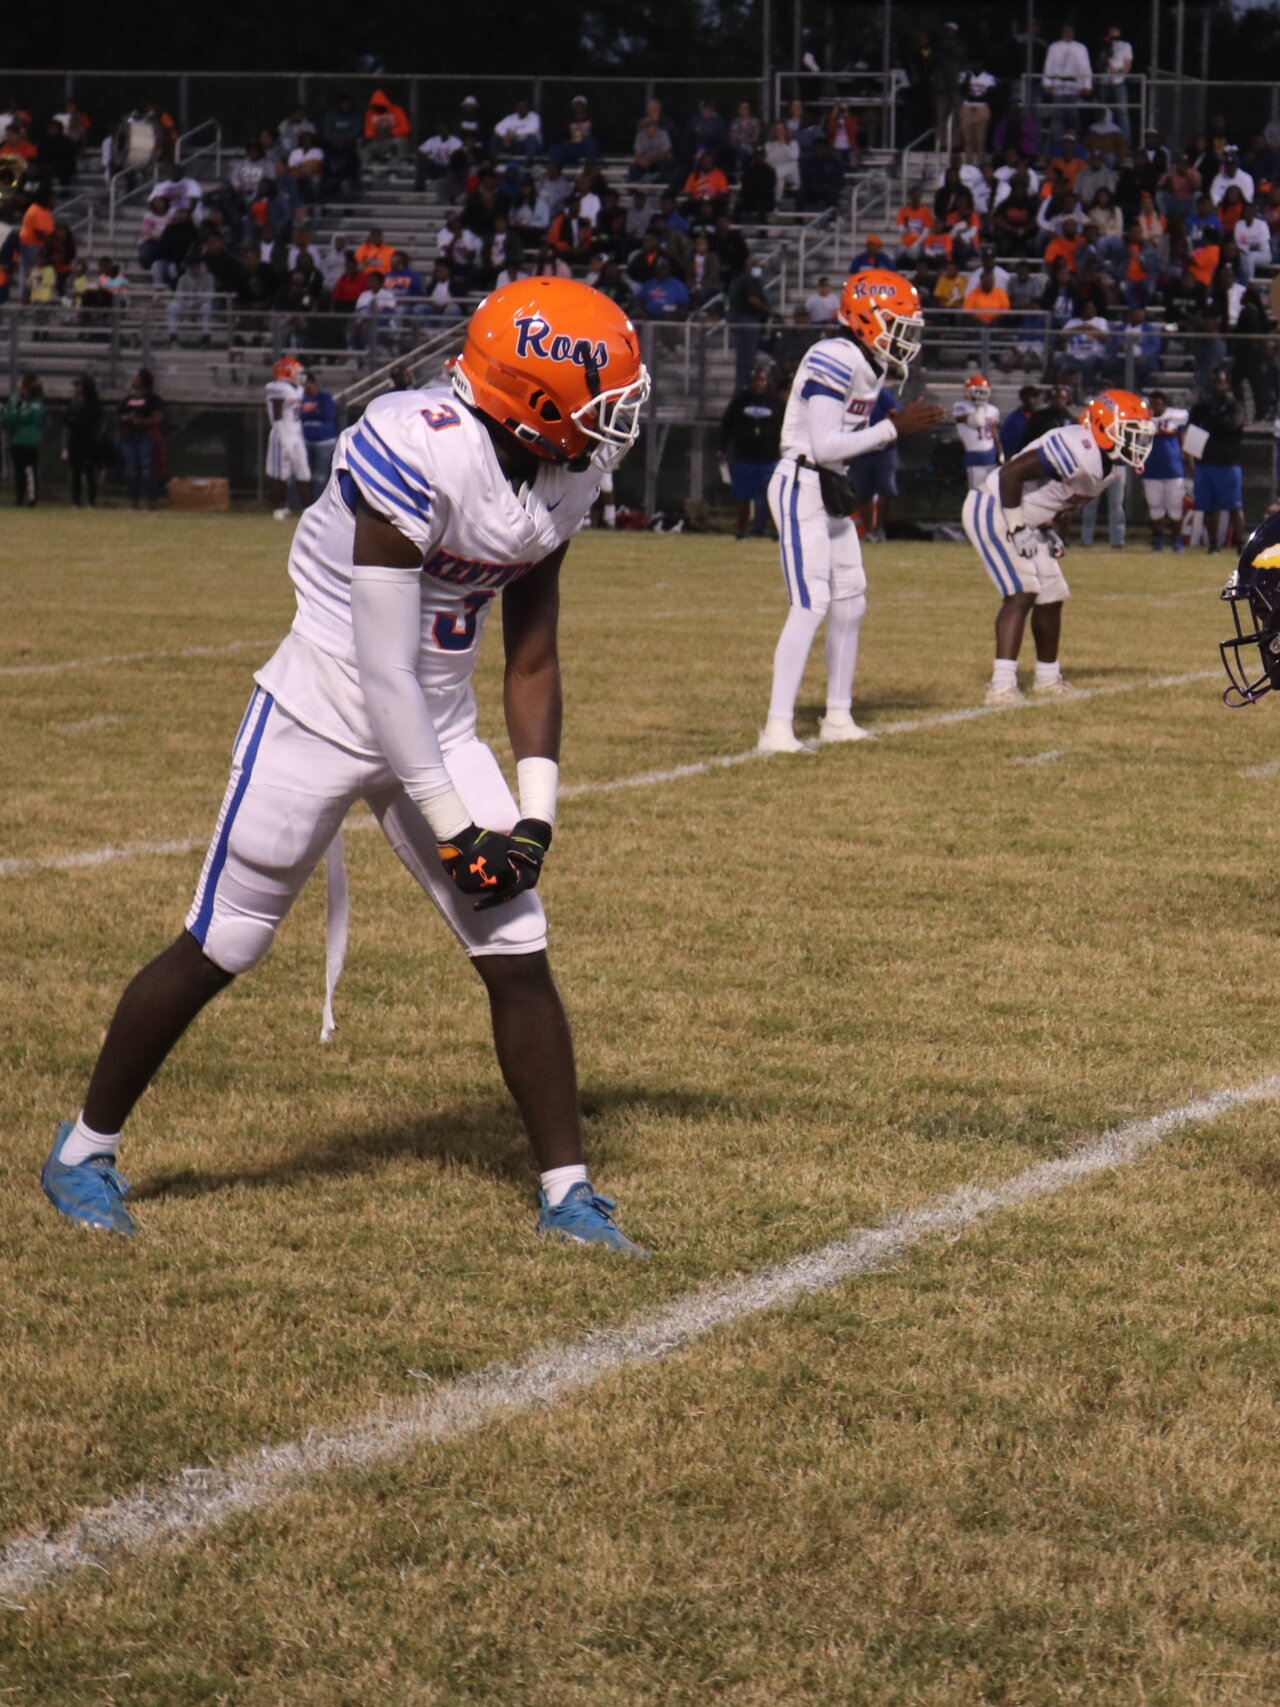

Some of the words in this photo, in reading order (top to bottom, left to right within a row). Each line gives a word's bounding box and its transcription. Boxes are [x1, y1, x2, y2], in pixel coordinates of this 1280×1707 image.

[853, 281, 896, 299] Roos
[514, 316, 609, 369] Roos
[420, 404, 462, 431] 3
